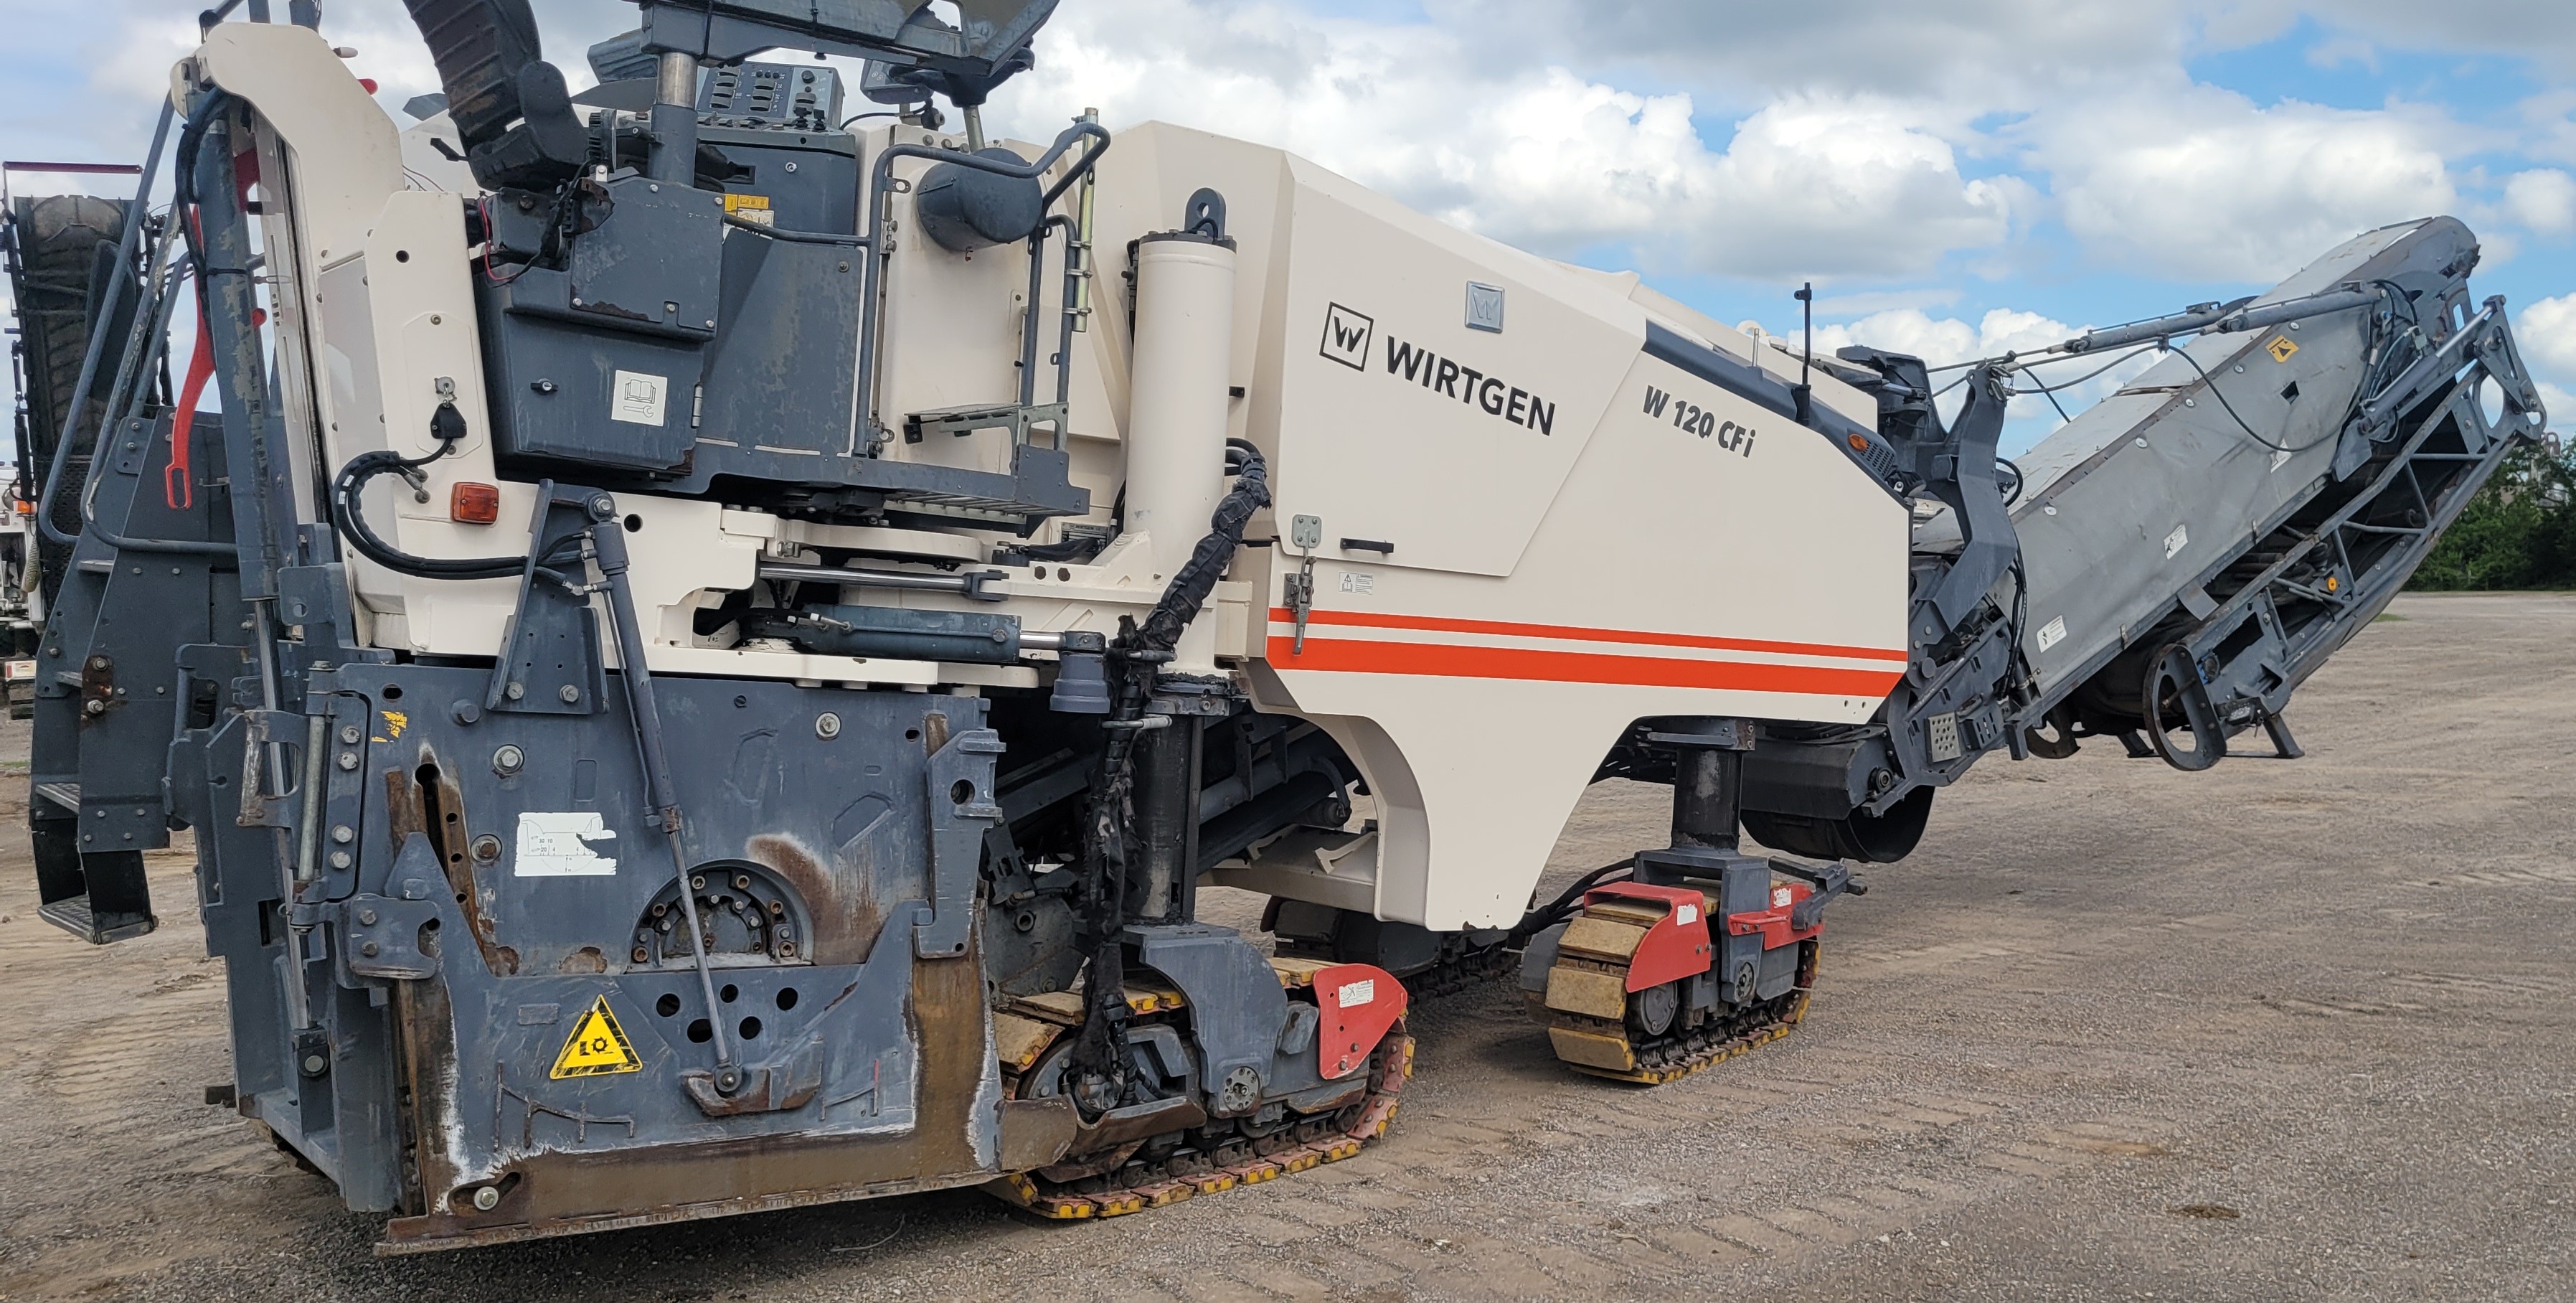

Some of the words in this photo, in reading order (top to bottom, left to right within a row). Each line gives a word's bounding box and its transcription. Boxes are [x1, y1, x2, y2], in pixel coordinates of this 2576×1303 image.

[1334, 316, 1365, 353] W
[1387, 334, 1555, 437] WIRTGEN
[1643, 385, 1671, 419] W
[1674, 400, 1714, 439] 120
